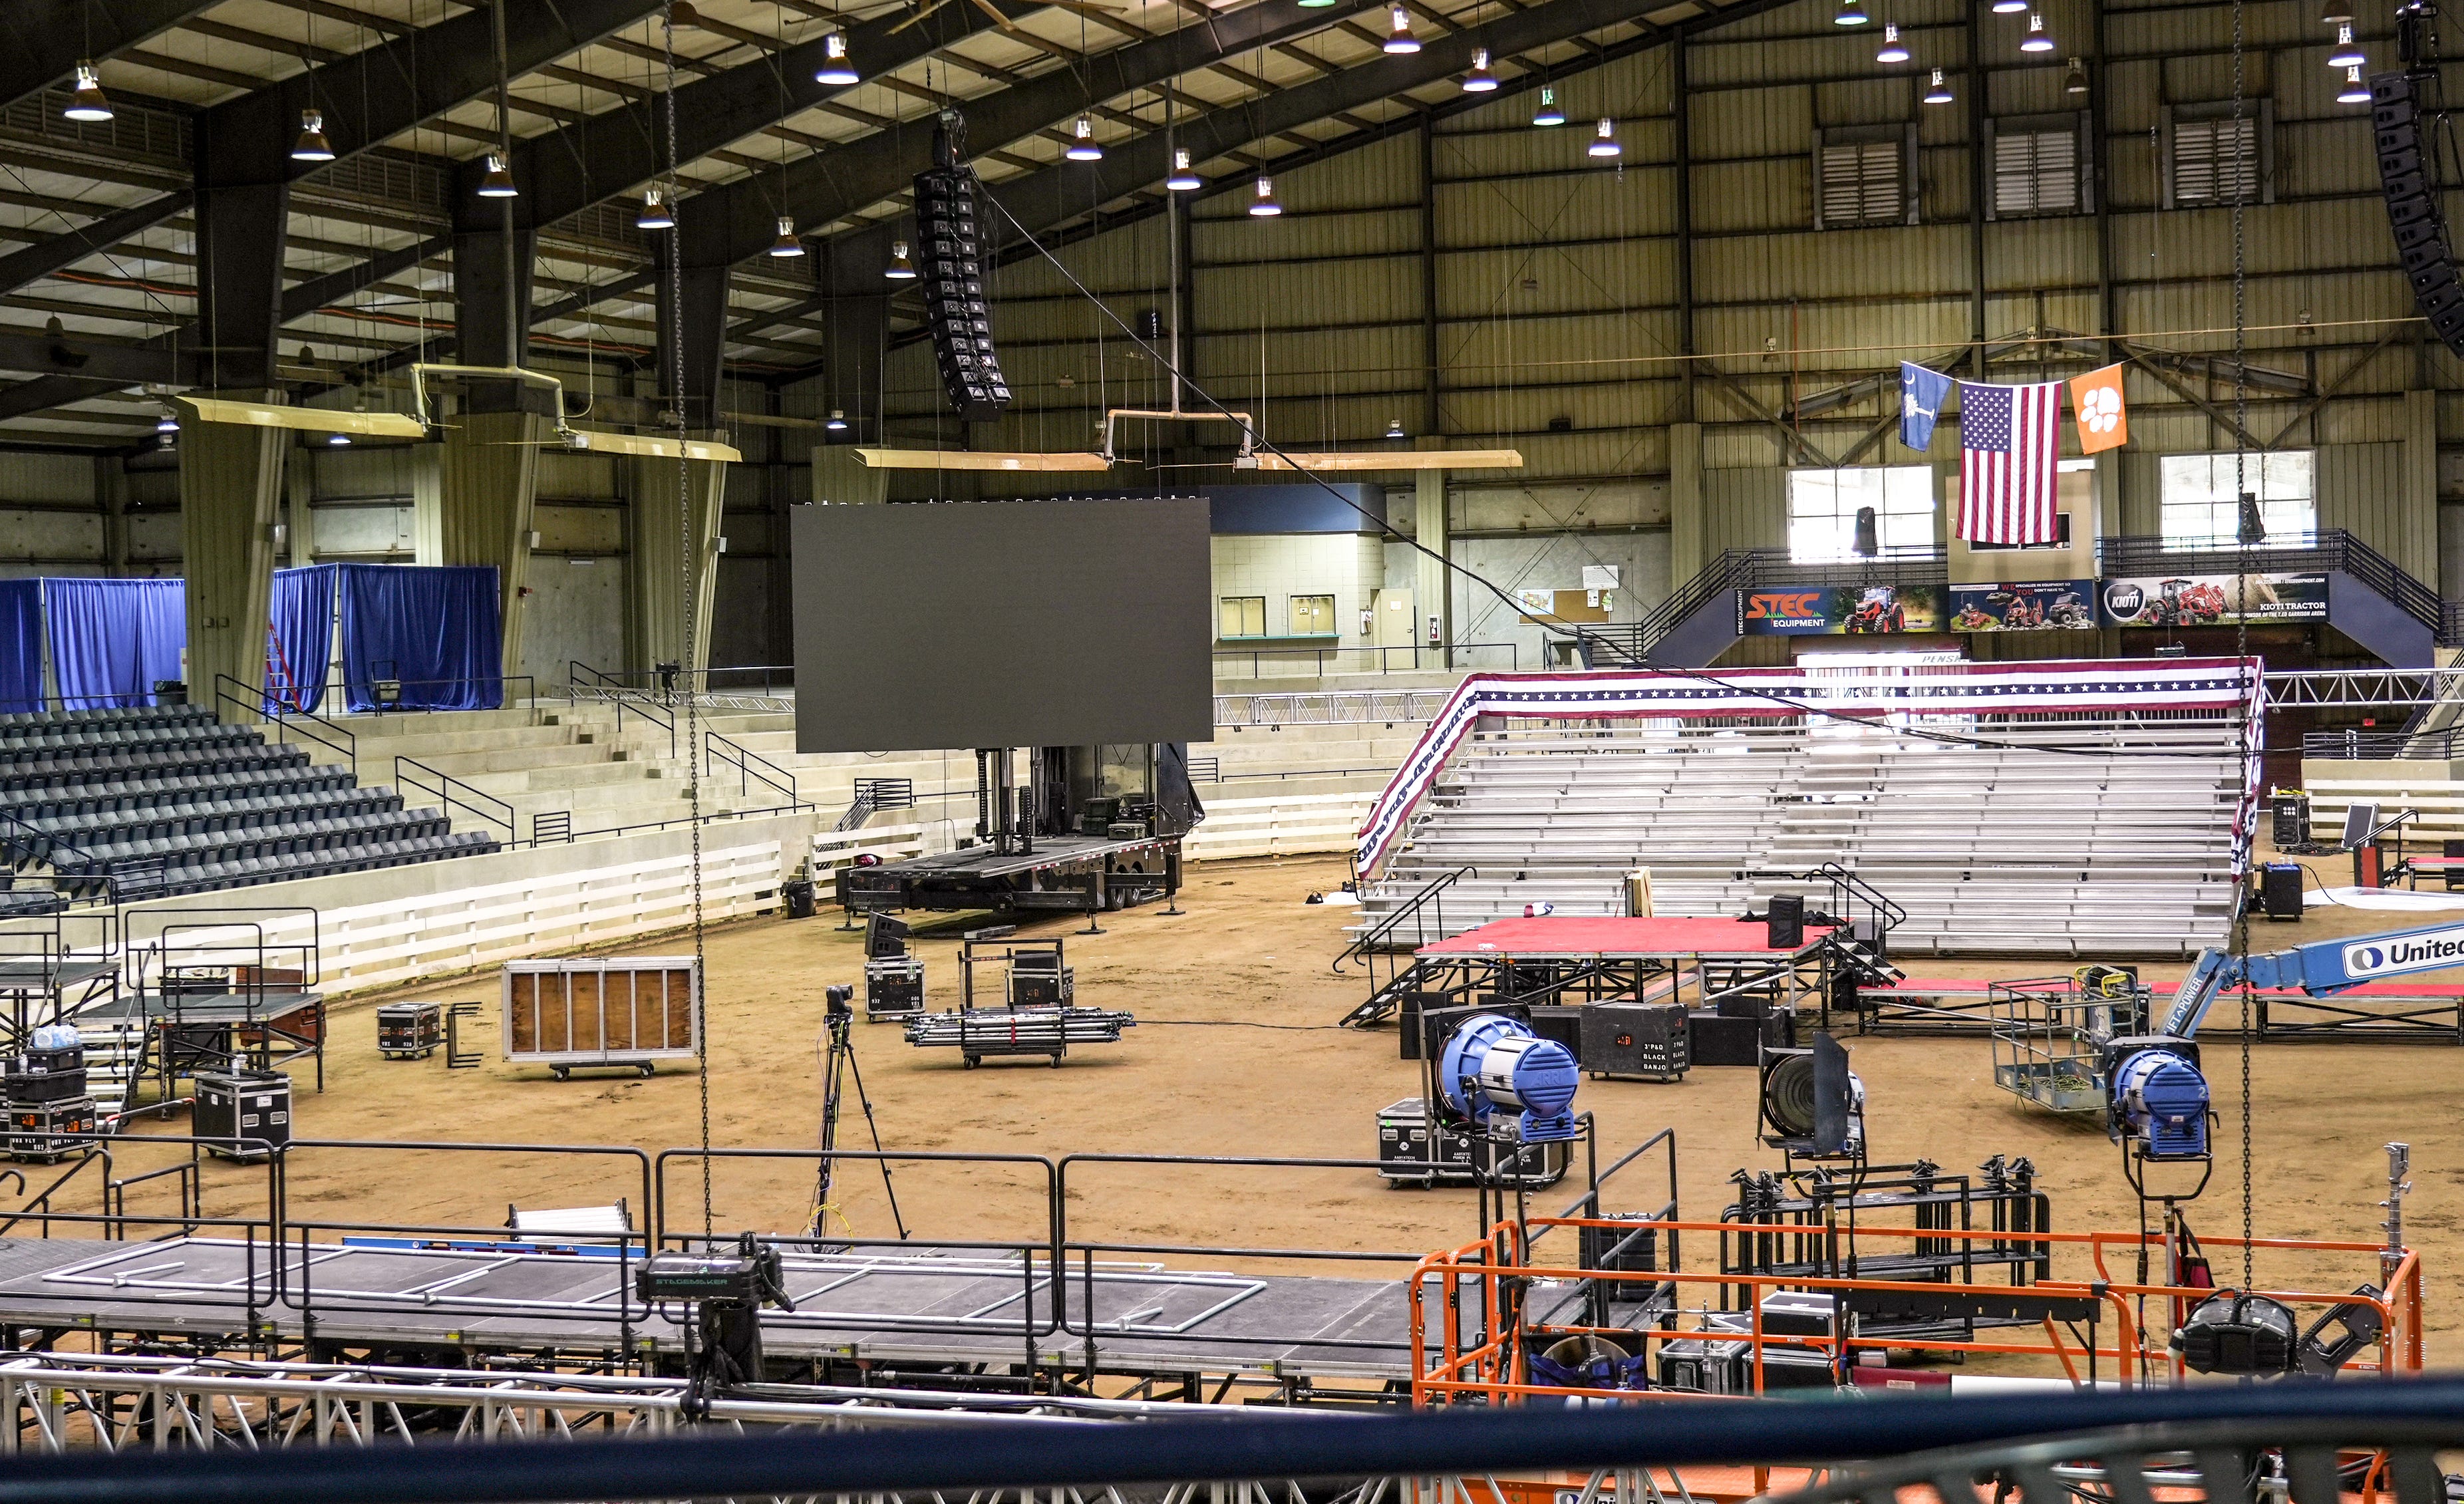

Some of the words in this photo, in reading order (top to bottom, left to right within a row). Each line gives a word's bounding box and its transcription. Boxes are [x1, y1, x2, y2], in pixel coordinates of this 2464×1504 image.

[1746, 593, 1820, 619] STEC
[2111, 595, 2139, 608] KIOTI
[2178, 977, 2203, 1012] POWER
[1531, 1072, 1561, 1086] ARRI
[2198, 1086, 2206, 1098] 2
